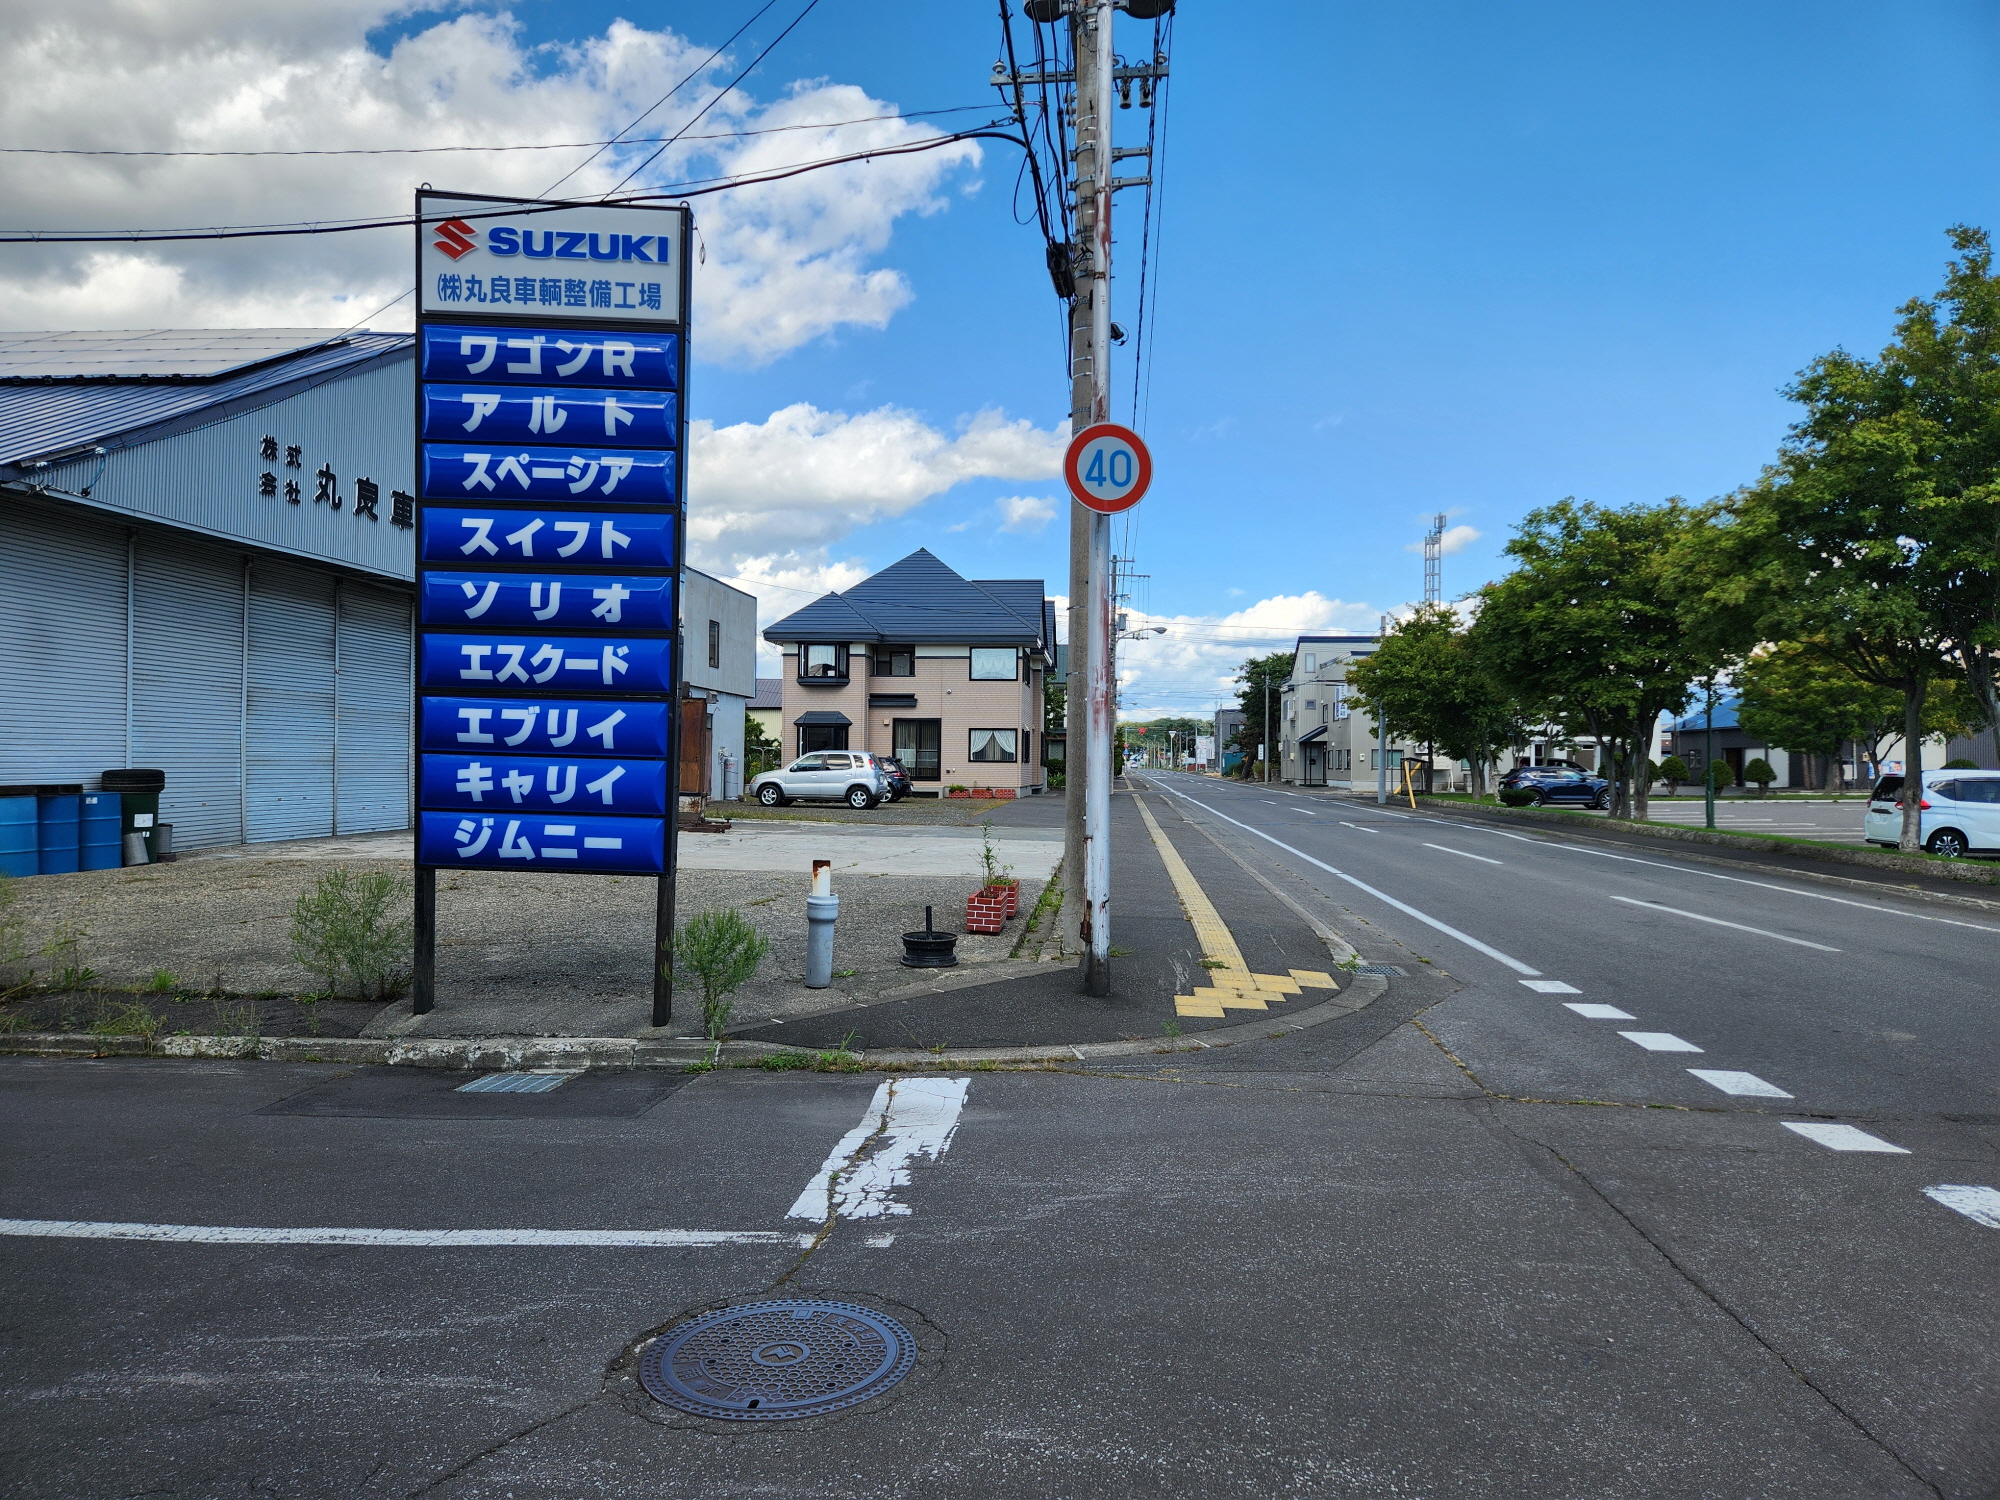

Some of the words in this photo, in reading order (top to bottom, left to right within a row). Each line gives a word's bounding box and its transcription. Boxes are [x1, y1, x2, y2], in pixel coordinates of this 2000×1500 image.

[488, 227, 669, 263] SUZUKI
[460, 335, 635, 377] ワゴンR
[461, 393, 635, 436] アルト
[462, 453, 634, 495] スペーシア
[1085, 449, 1132, 488] 40
[460, 518, 632, 558] スイフト
[460, 581, 630, 622] ソリオ
[460, 643, 629, 685] エスクード
[457, 705, 627, 749] エブリイ
[456, 762, 627, 805] キャリイ
[454, 818, 622, 861] ジムニー
